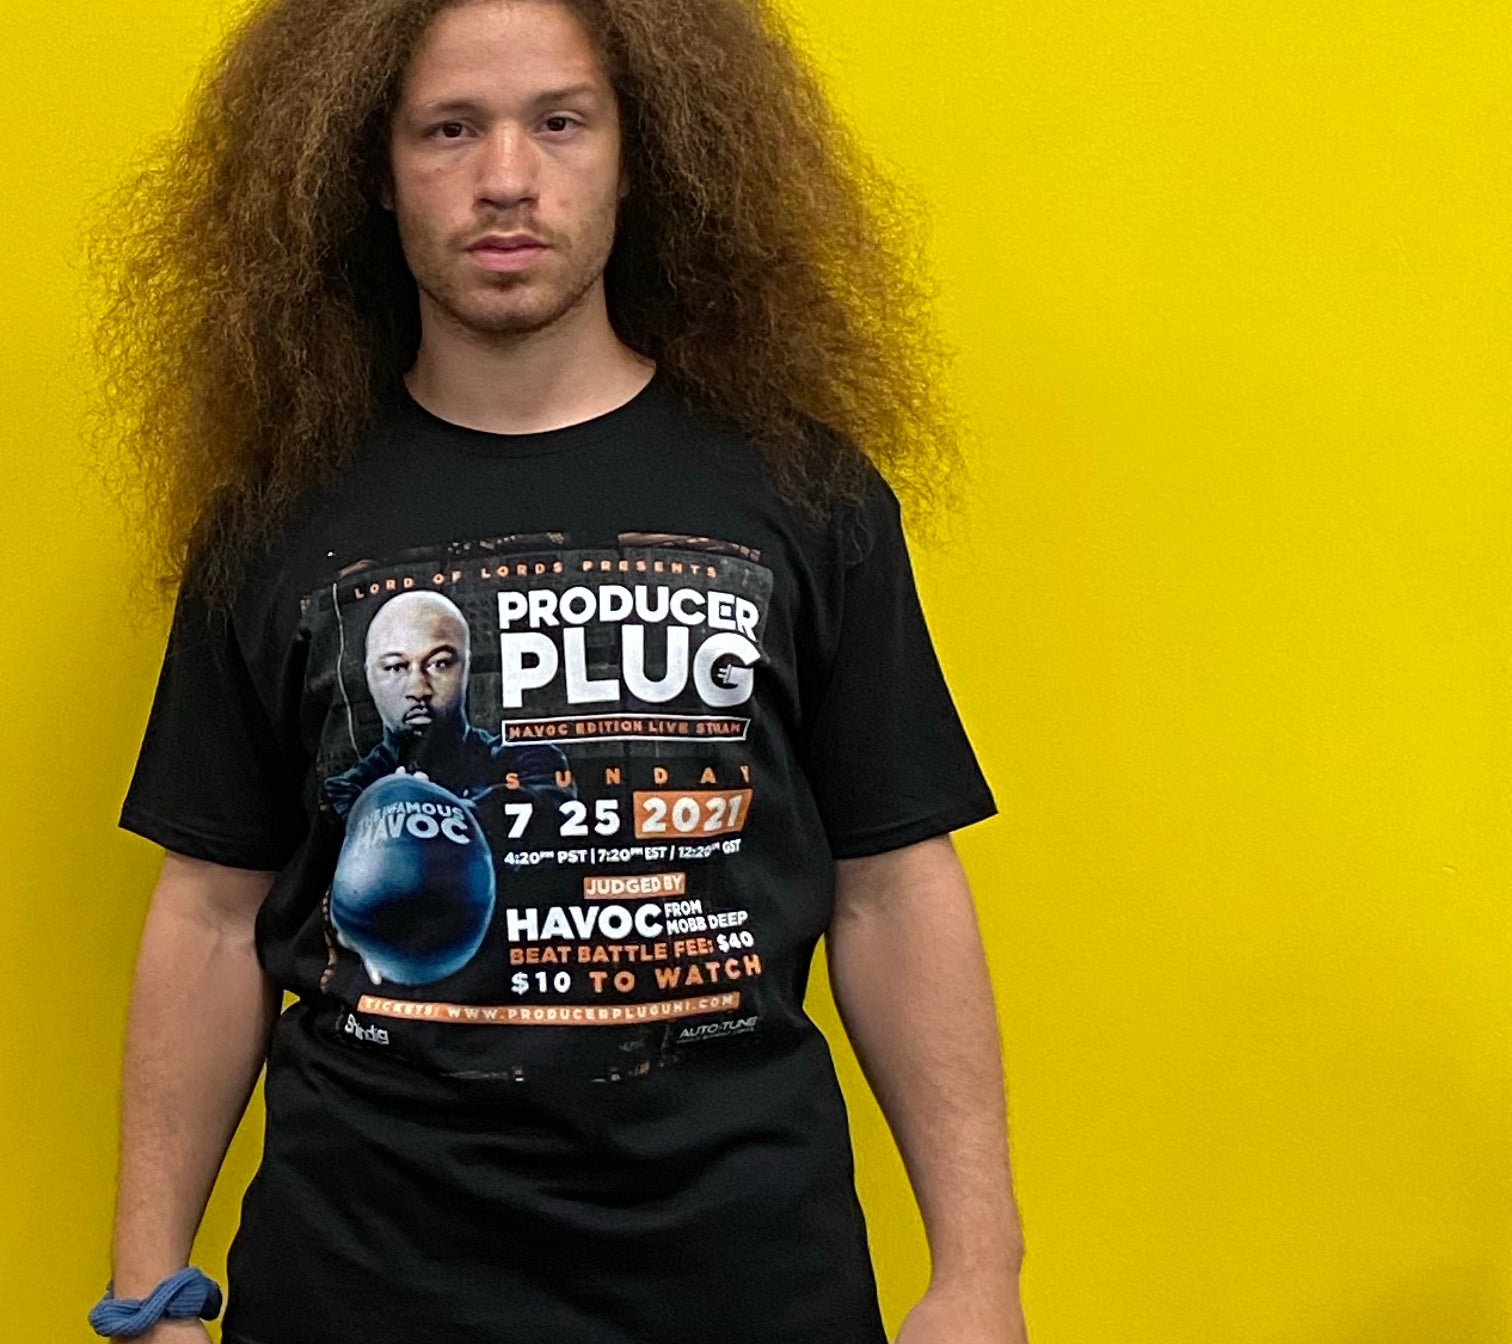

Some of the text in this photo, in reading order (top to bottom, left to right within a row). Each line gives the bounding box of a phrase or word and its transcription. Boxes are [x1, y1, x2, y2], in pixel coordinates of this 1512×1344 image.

[354, 560, 717, 599] LORD OF LORDS PRESENTS
[497, 585, 760, 642] PRODUCER
[499, 625, 762, 708] PLUG
[509, 724, 568, 739] HAVOC
[576, 719, 642, 735] EDITION
[648, 719, 689, 733] LIVE
[504, 795, 744, 839] 7 25 2021
[557, 850, 588, 863] PST
[644, 846, 668, 860] EST
[586, 874, 683, 895] JUDGED BY
[506, 904, 664, 942] HAVOC
[664, 899, 702, 918] FROM
[666, 910, 749, 935] MOBB DEEP
[509, 931, 754, 964] BEAT BATTLE FEE: $40
[511, 954, 762, 994] $10 TO WATCH
